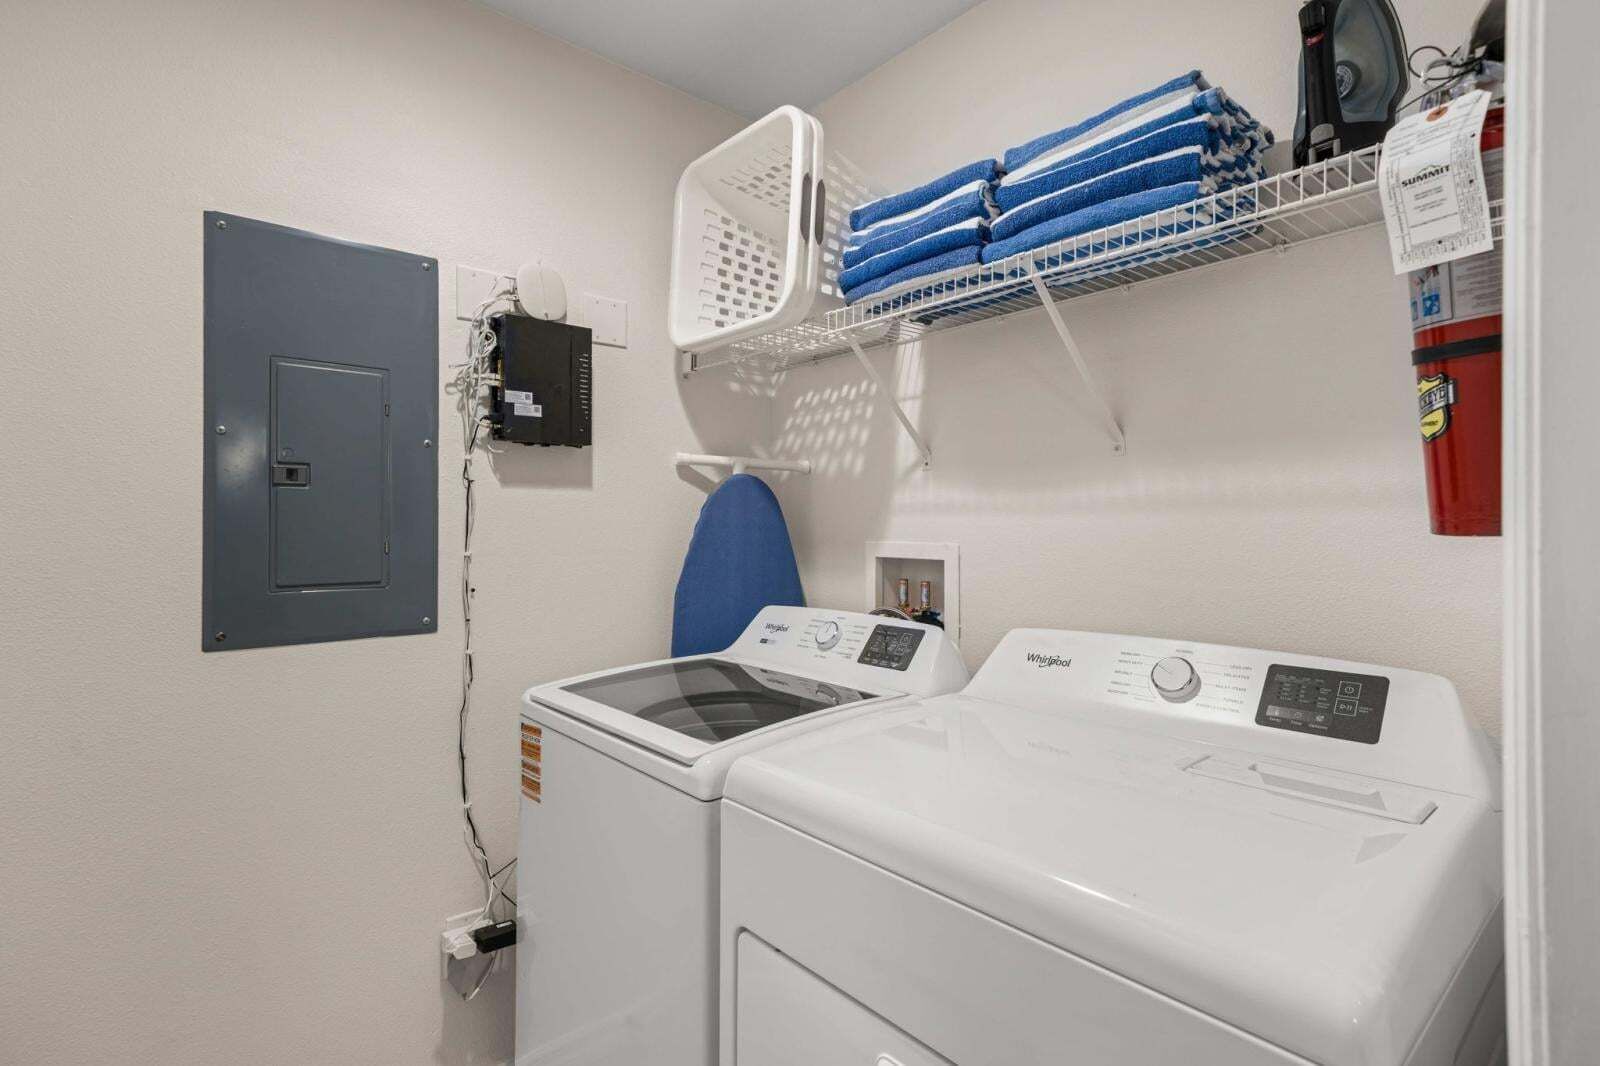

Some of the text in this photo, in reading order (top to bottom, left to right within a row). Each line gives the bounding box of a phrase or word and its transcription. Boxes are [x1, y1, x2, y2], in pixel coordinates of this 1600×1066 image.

[1402, 165, 1450, 188] SUMMIT
[765, 622, 790, 634] Whirlpool
[1026, 652, 1072, 669] Whirlpool
